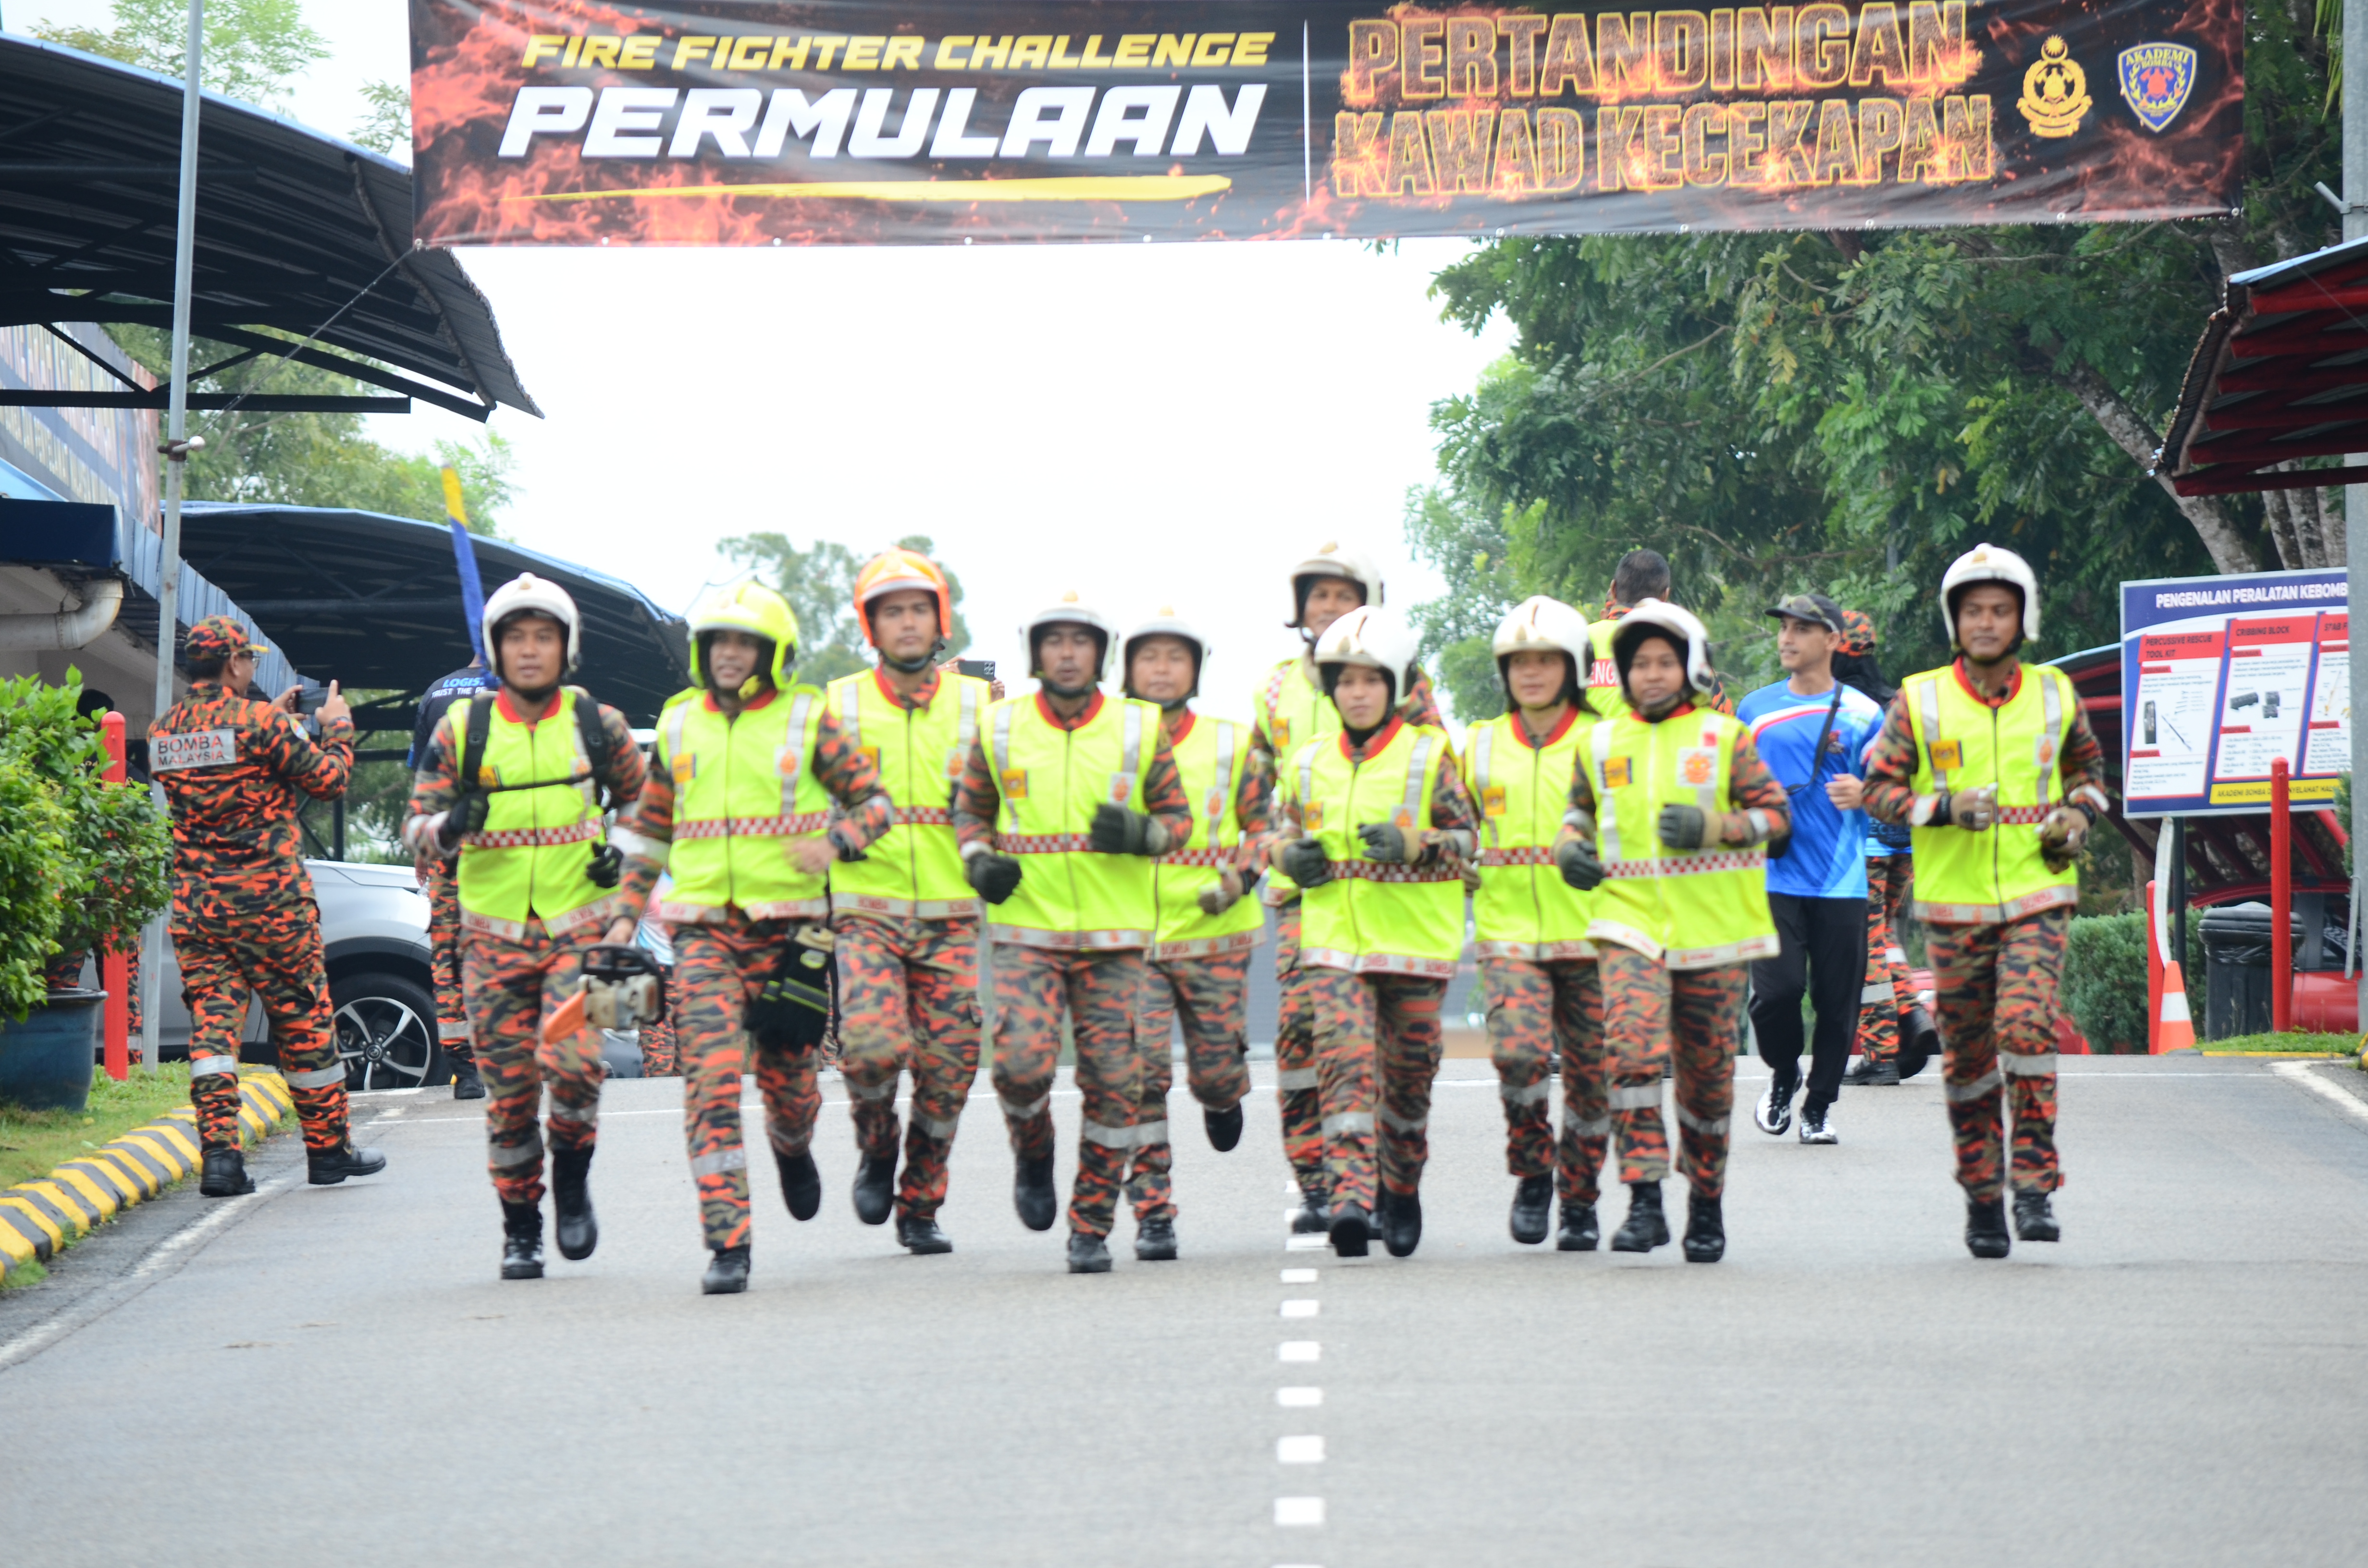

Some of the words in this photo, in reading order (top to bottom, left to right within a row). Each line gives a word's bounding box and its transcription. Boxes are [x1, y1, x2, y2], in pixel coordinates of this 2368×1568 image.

[521, 34, 662, 69] FIRE
[671, 36, 925, 71] FIGHTER
[934, 32, 1276, 70] CHALLENGE
[1348, 0, 1967, 99] PERTANDINGAN
[2125, 49, 2190, 66] AKADEMI
[497, 84, 1268, 158] PERMULAAN
[1335, 107, 1584, 197] KAWAD
[1597, 94, 1992, 191] KECEKAPAN
[2156, 589, 2232, 608] PENGENALAN
[2232, 585, 2298, 603] PERALATAN
[2300, 582, 2348, 600] KEBOMB
[2268, 626, 2290, 635] BLOCK
[2187, 635, 2212, 644] RESCUE
[2146, 650, 2164, 659] TOOL
[432, 688, 454, 698] TRUST
[456, 687, 472, 696] THE
[158, 735, 223, 754] BOMBA
[158, 750, 225, 766] MALAYSIA
[2217, 789, 2244, 797] AKADEMI
